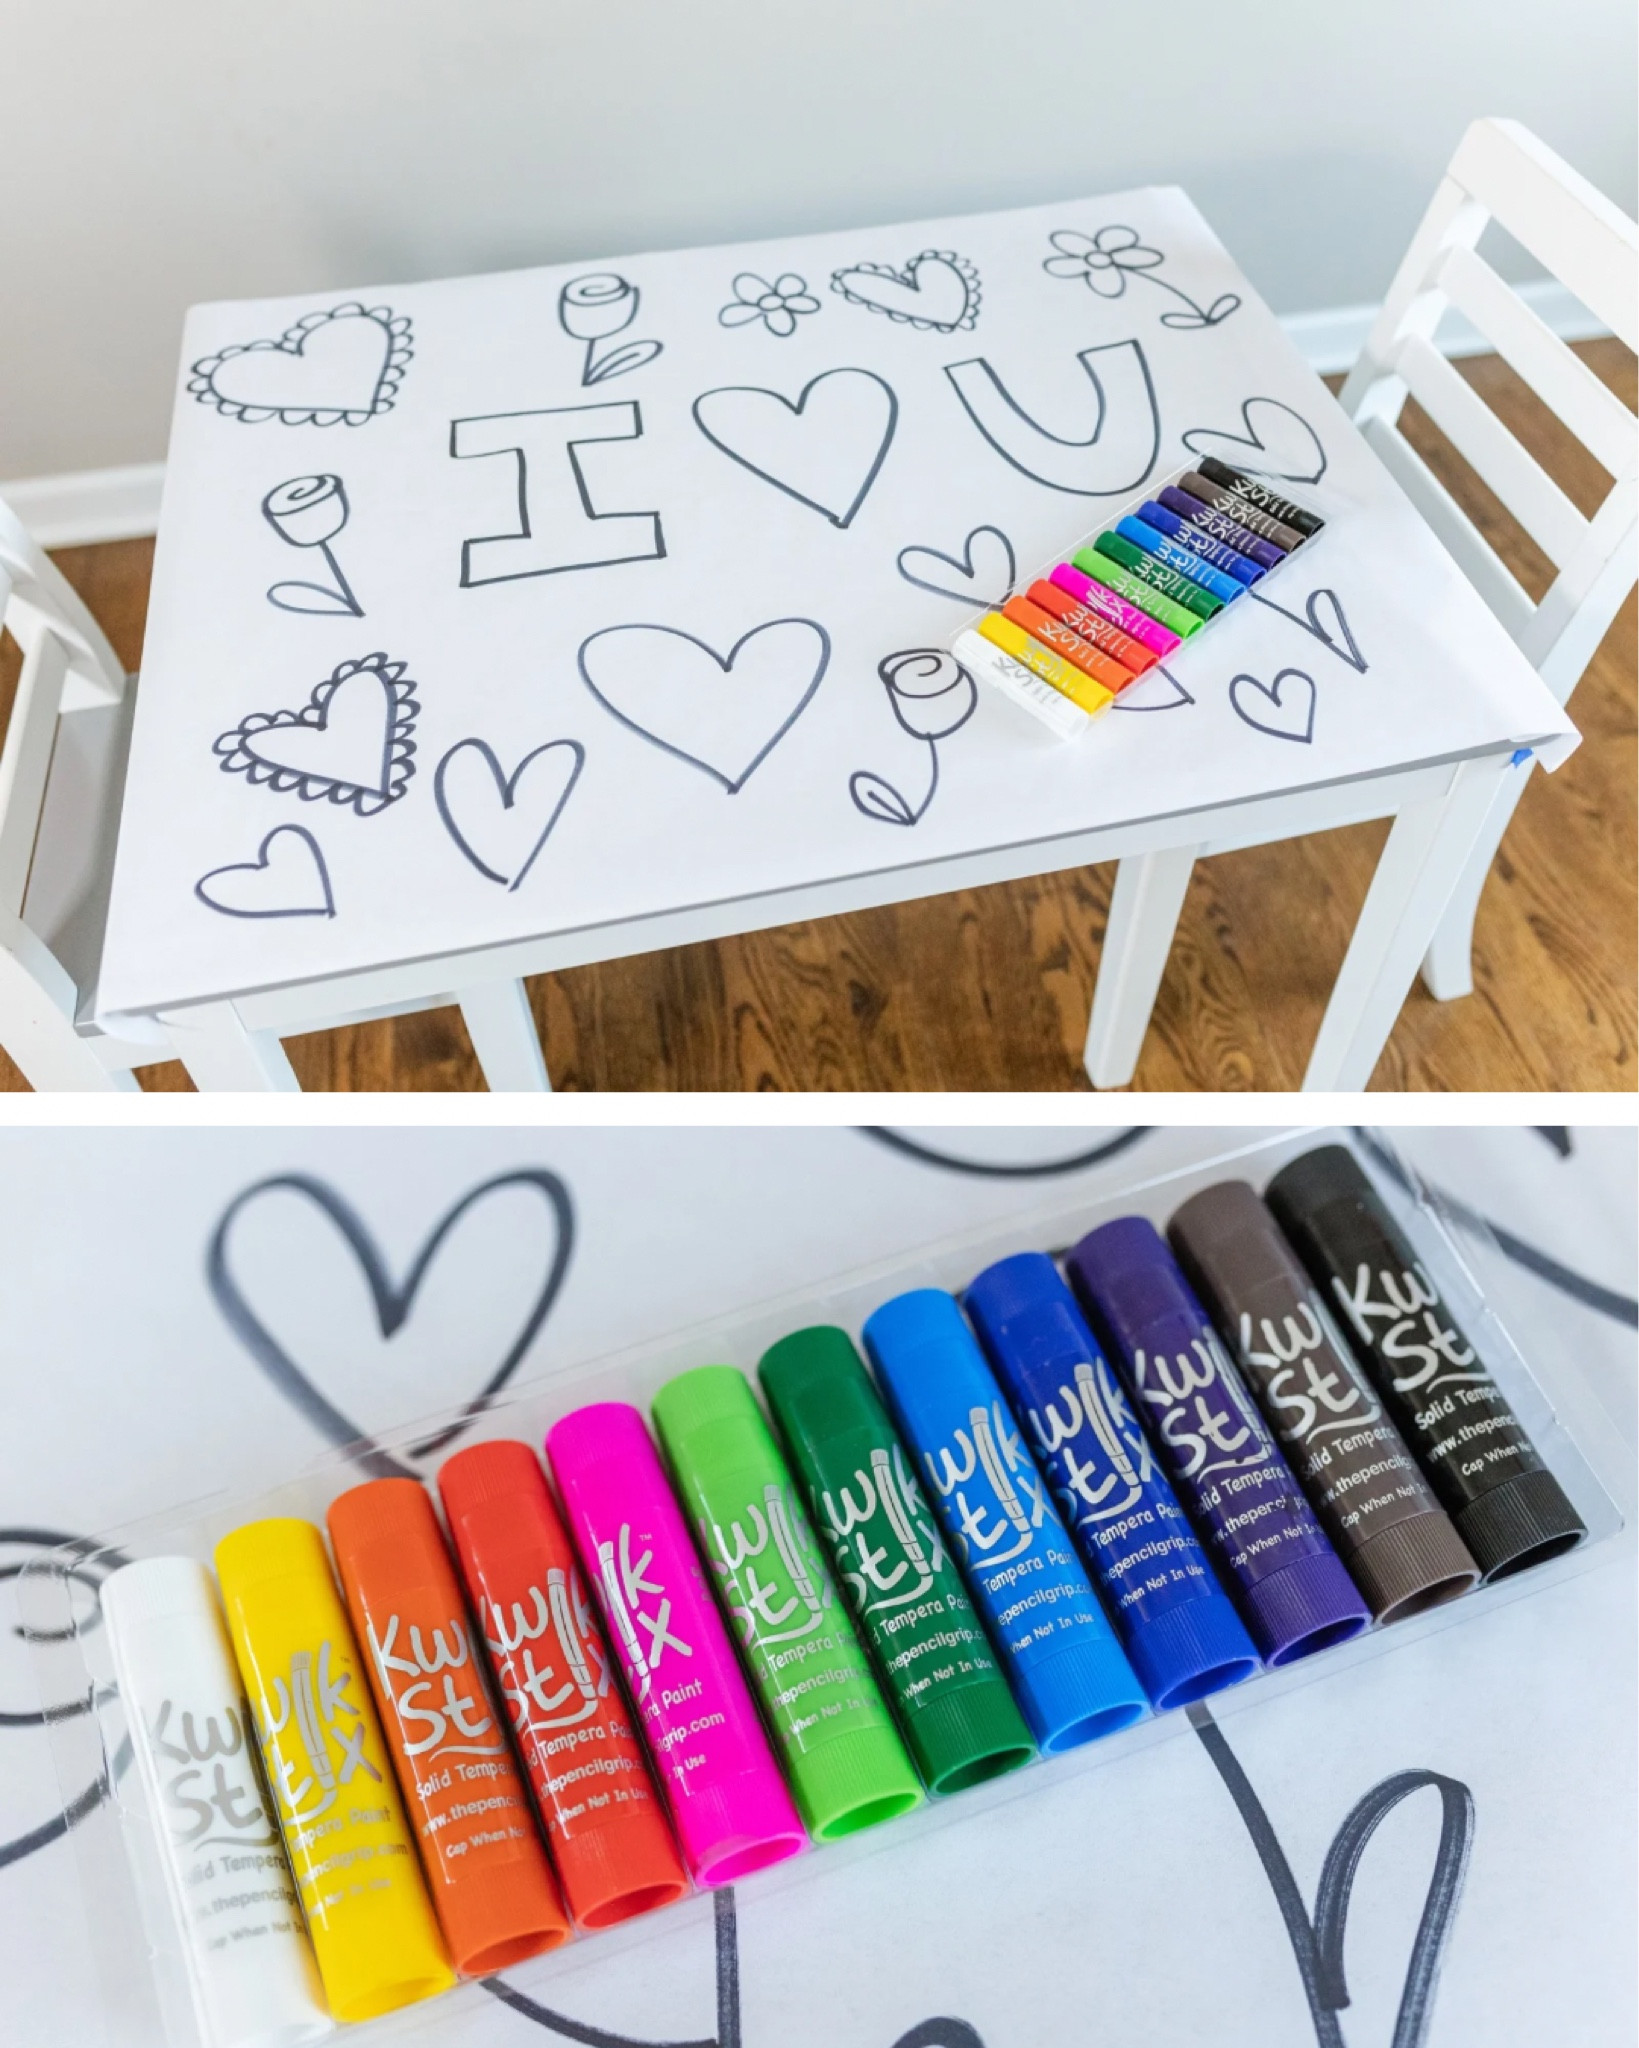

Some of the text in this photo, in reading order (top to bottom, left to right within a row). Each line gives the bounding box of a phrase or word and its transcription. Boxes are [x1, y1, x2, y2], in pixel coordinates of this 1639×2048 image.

[450, 338, 1161, 588] I U
[1381, 1310, 1476, 1392] St
[1267, 1356, 1360, 1441] St
[1414, 1394, 1456, 1431] Solid
[1160, 1395, 1251, 1479] St
[1461, 1458, 1485, 1477] Cap
[1483, 1445, 1519, 1463] When
[1358, 1492, 1396, 1515] When
[1090, 1508, 1155, 1550] Tempera
[1246, 1533, 1282, 1556] When
[982, 1556, 1045, 1595] Tempera
[1145, 1573, 1168, 1592] Not
[1169, 1569, 1186, 1582] In
[879, 1599, 945, 1637] Tempera
[1032, 1621, 1055, 1641] Not
[1056, 1616, 1073, 1629] In
[767, 1636, 833, 1673] Tempera
[932, 1664, 955, 1683] Not
[957, 1660, 973, 1673] In
[661, 1677, 703, 1710] Paint
[397, 1674, 492, 1756] St
[537, 1725, 606, 1758] Tempera
[415, 1768, 453, 1801] Solid
